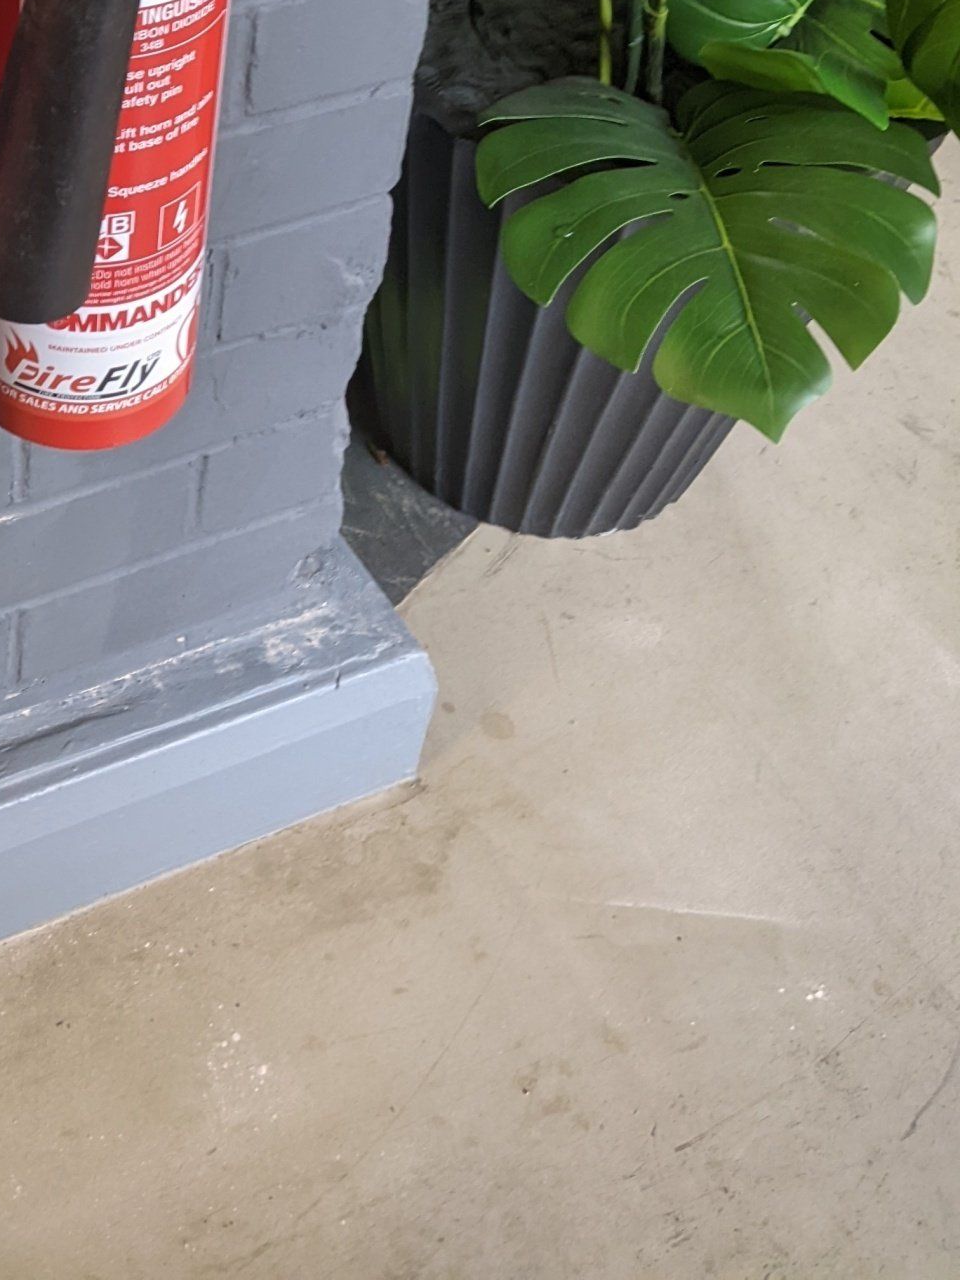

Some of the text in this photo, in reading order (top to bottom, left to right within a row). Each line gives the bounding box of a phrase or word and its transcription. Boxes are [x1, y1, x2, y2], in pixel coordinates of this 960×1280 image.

[134, 24, 170, 41] BON
[126, 50, 196, 81] se upright
[124, 75, 171, 95] ull out
[122, 84, 183, 109] afety pin
[140, 119, 172, 137] horn
[128, 136, 163, 152] base
[166, 127, 180, 141] of
[108, 176, 169, 199] Squeeze
[111, 216, 130, 234] B
[114, 266, 133, 278] not
[46, 270, 200, 332] OMMANDE
[48, 343, 108, 354] MAINTAINED
[110, 338, 142, 353] UNDER
[18, 394, 57, 412] SALES
[58, 404, 90, 415] AND
[90, 394, 143, 414] SERVICE
[143, 382, 169, 401] CALL
